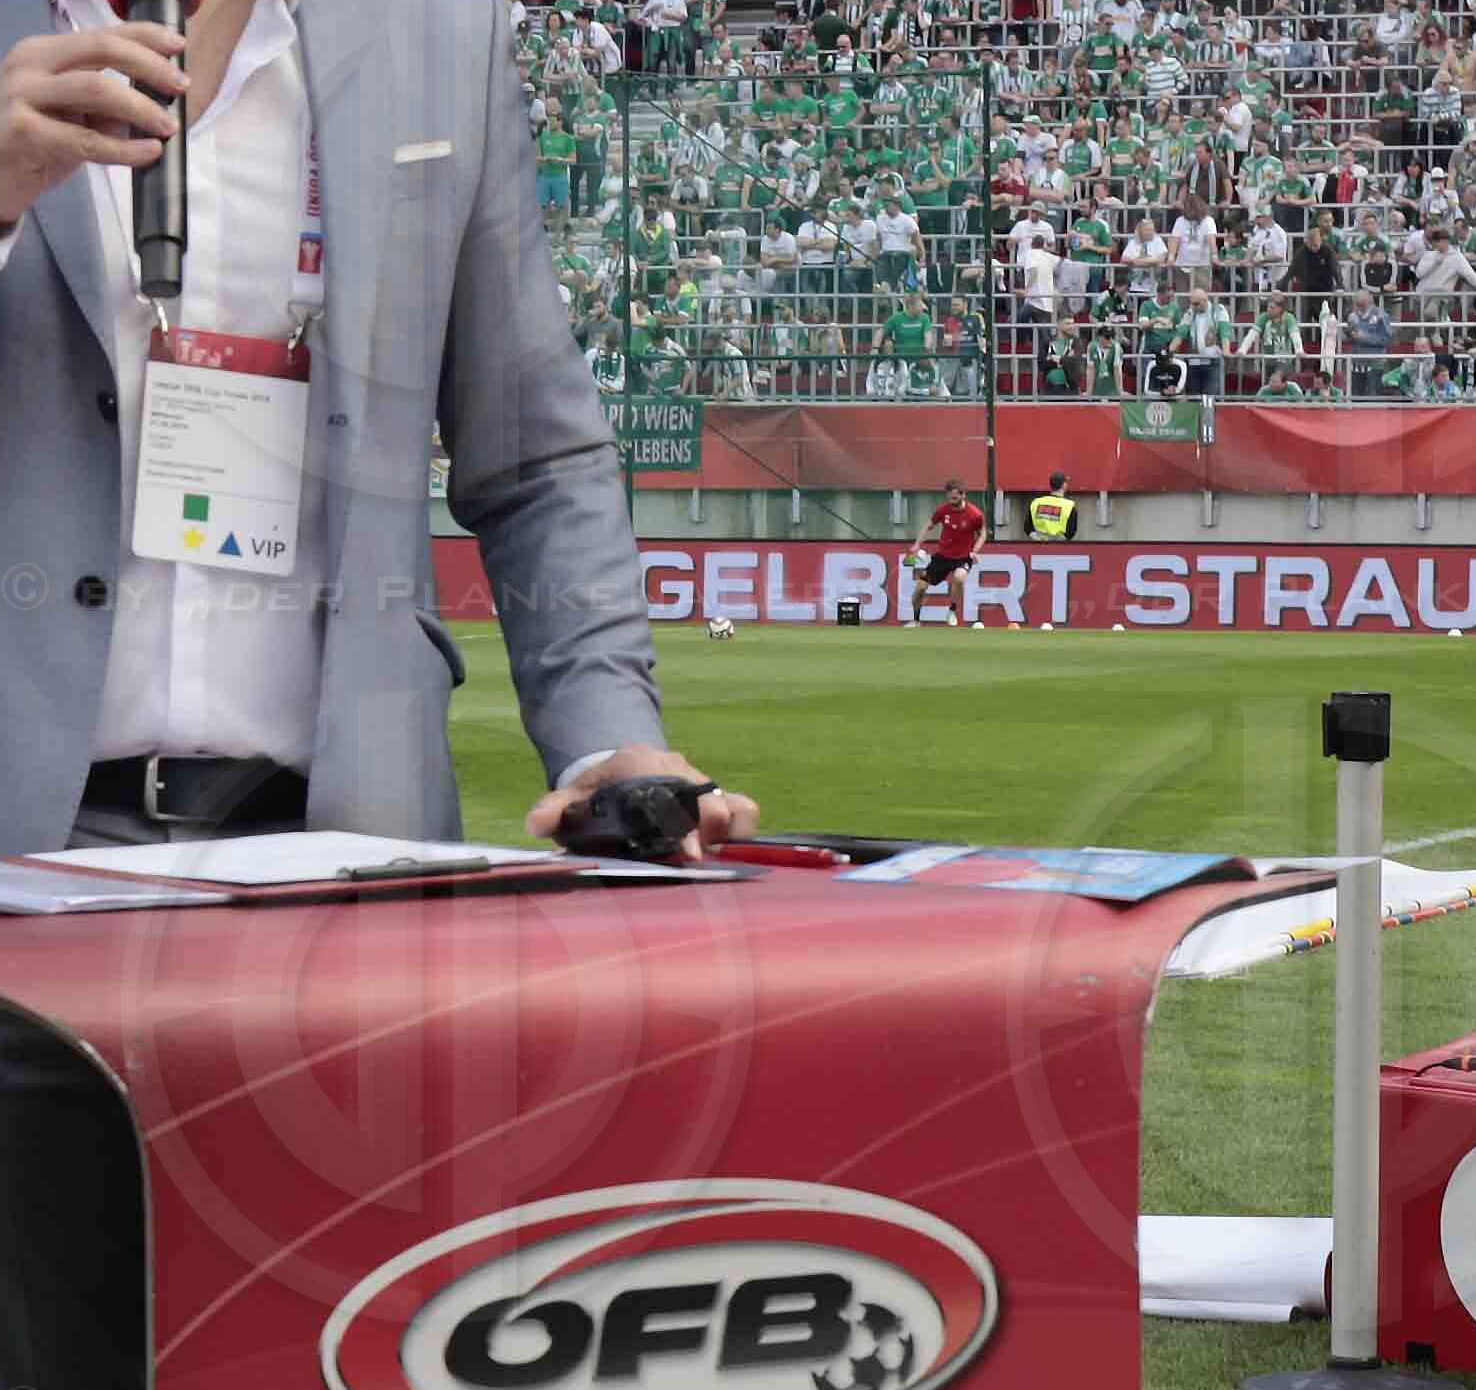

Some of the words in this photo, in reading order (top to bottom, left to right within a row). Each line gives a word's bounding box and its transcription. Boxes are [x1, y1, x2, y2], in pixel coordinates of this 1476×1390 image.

[645, 403, 695, 431] WIEN
[634, 440, 692, 463] LEBENS
[251, 537, 287, 559] VIP
[640, 550, 1091, 624] GELBERT
